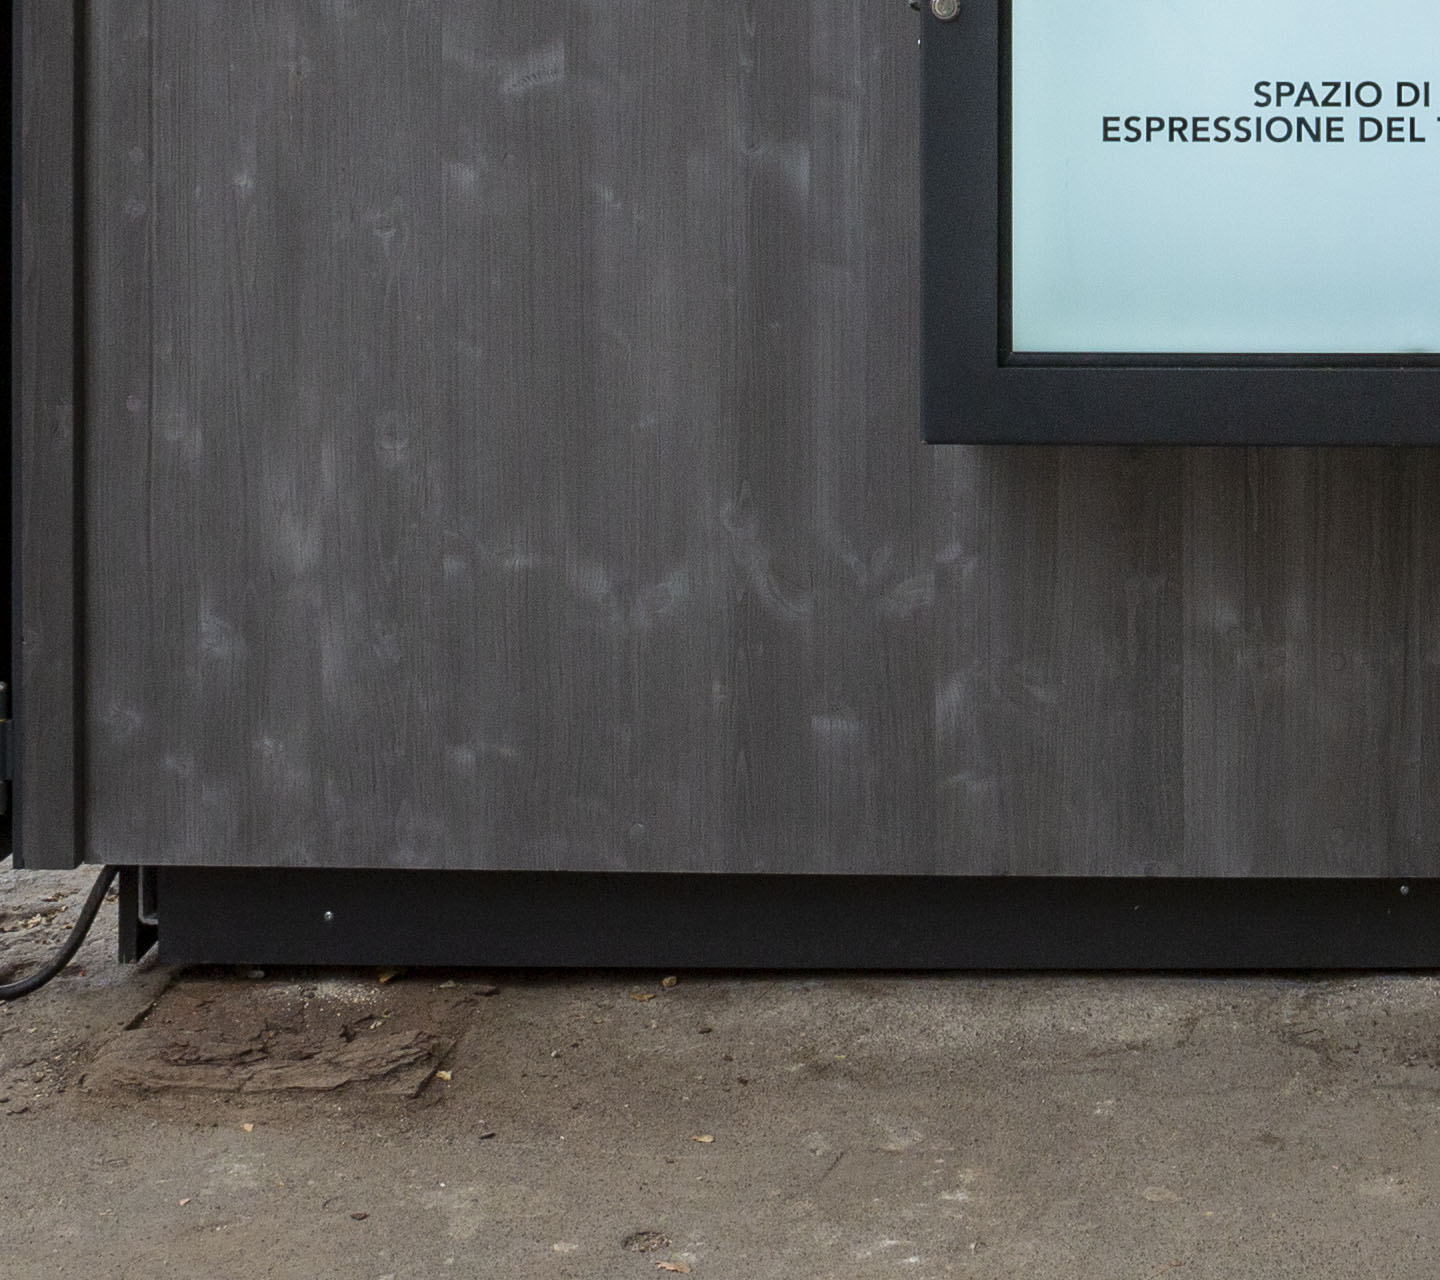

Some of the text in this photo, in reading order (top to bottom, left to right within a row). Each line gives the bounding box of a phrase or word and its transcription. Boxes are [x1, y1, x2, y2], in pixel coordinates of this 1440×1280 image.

[1254, 80, 1382, 108] SPAZIO
[1396, 81, 1430, 107] DI
[1102, 116, 1345, 143] ESPRESSIONE
[1359, 116, 1426, 143] DEL
